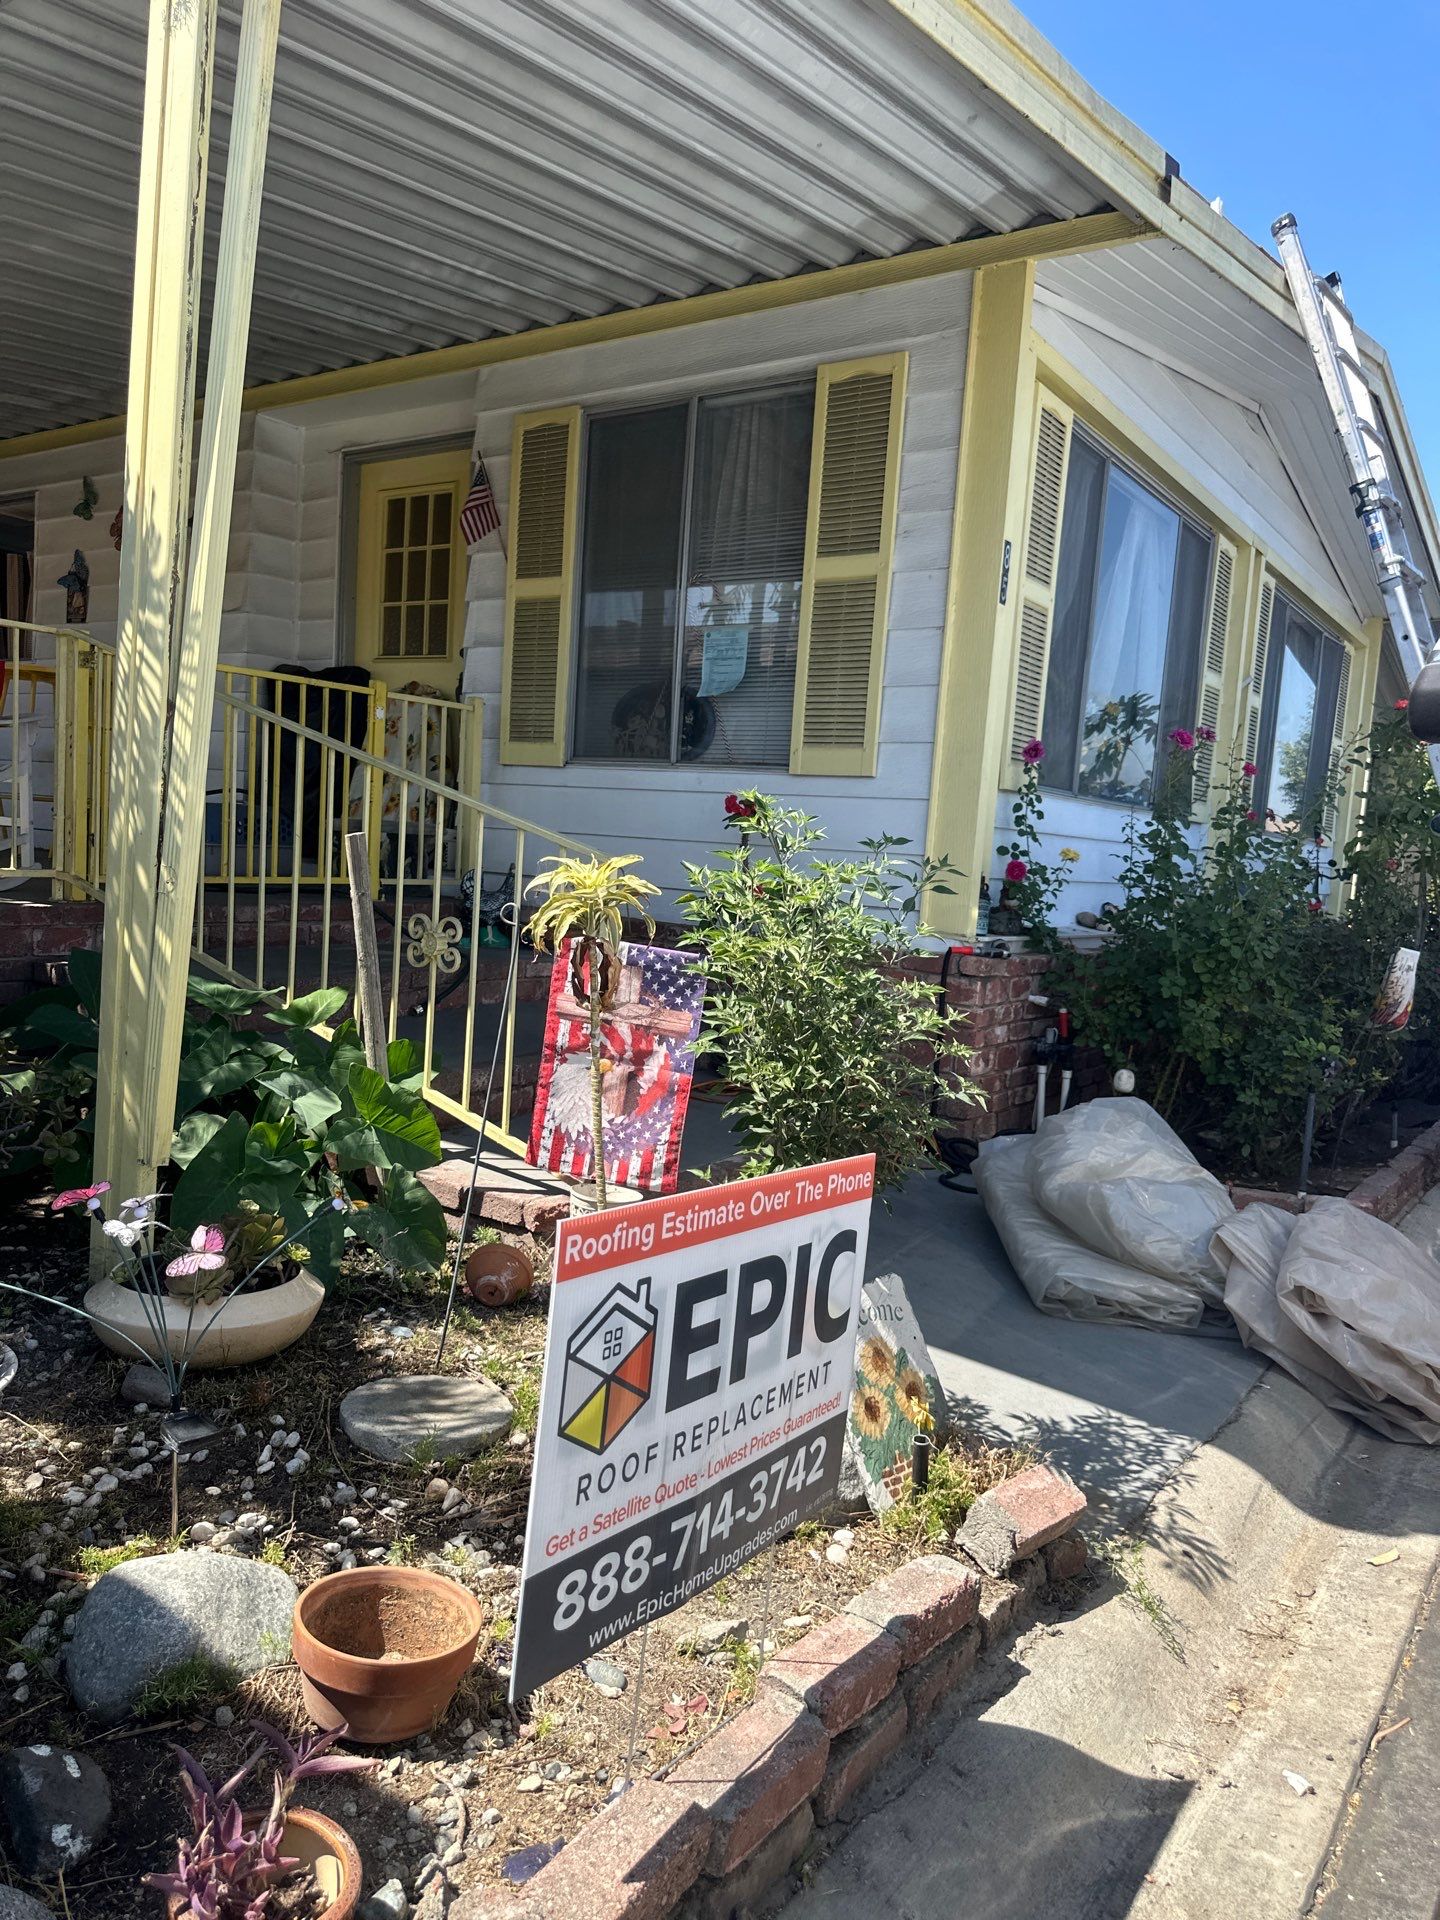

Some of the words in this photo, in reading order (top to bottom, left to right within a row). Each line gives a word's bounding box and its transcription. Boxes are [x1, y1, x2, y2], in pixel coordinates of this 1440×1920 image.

[564, 1220, 656, 1265] Roofing
[661, 1199, 745, 1240] Estimate
[750, 1189, 791, 1216] Over
[795, 1179, 824, 1205] The
[827, 1171, 872, 1197] Phone
[665, 1228, 858, 1414] EPIC
[858, 1303, 904, 1325] come
[545, 1528, 576, 1557] Get
[578, 1525, 589, 1542] a
[592, 1495, 652, 1535] Satellite
[654, 1473, 698, 1504] Quote
[707, 1442, 748, 1480] Lowest
[750, 1426, 781, 1455] Prices
[783, 1391, 842, 1436] Guaranteed!
[575, 1442, 660, 1506] ROOF
[672, 1360, 832, 1462] REPLACEMENT
[553, 1435, 828, 1632] 888-714-3742
[588, 1509, 799, 1648] www.EpicHomeUpgrades.com
